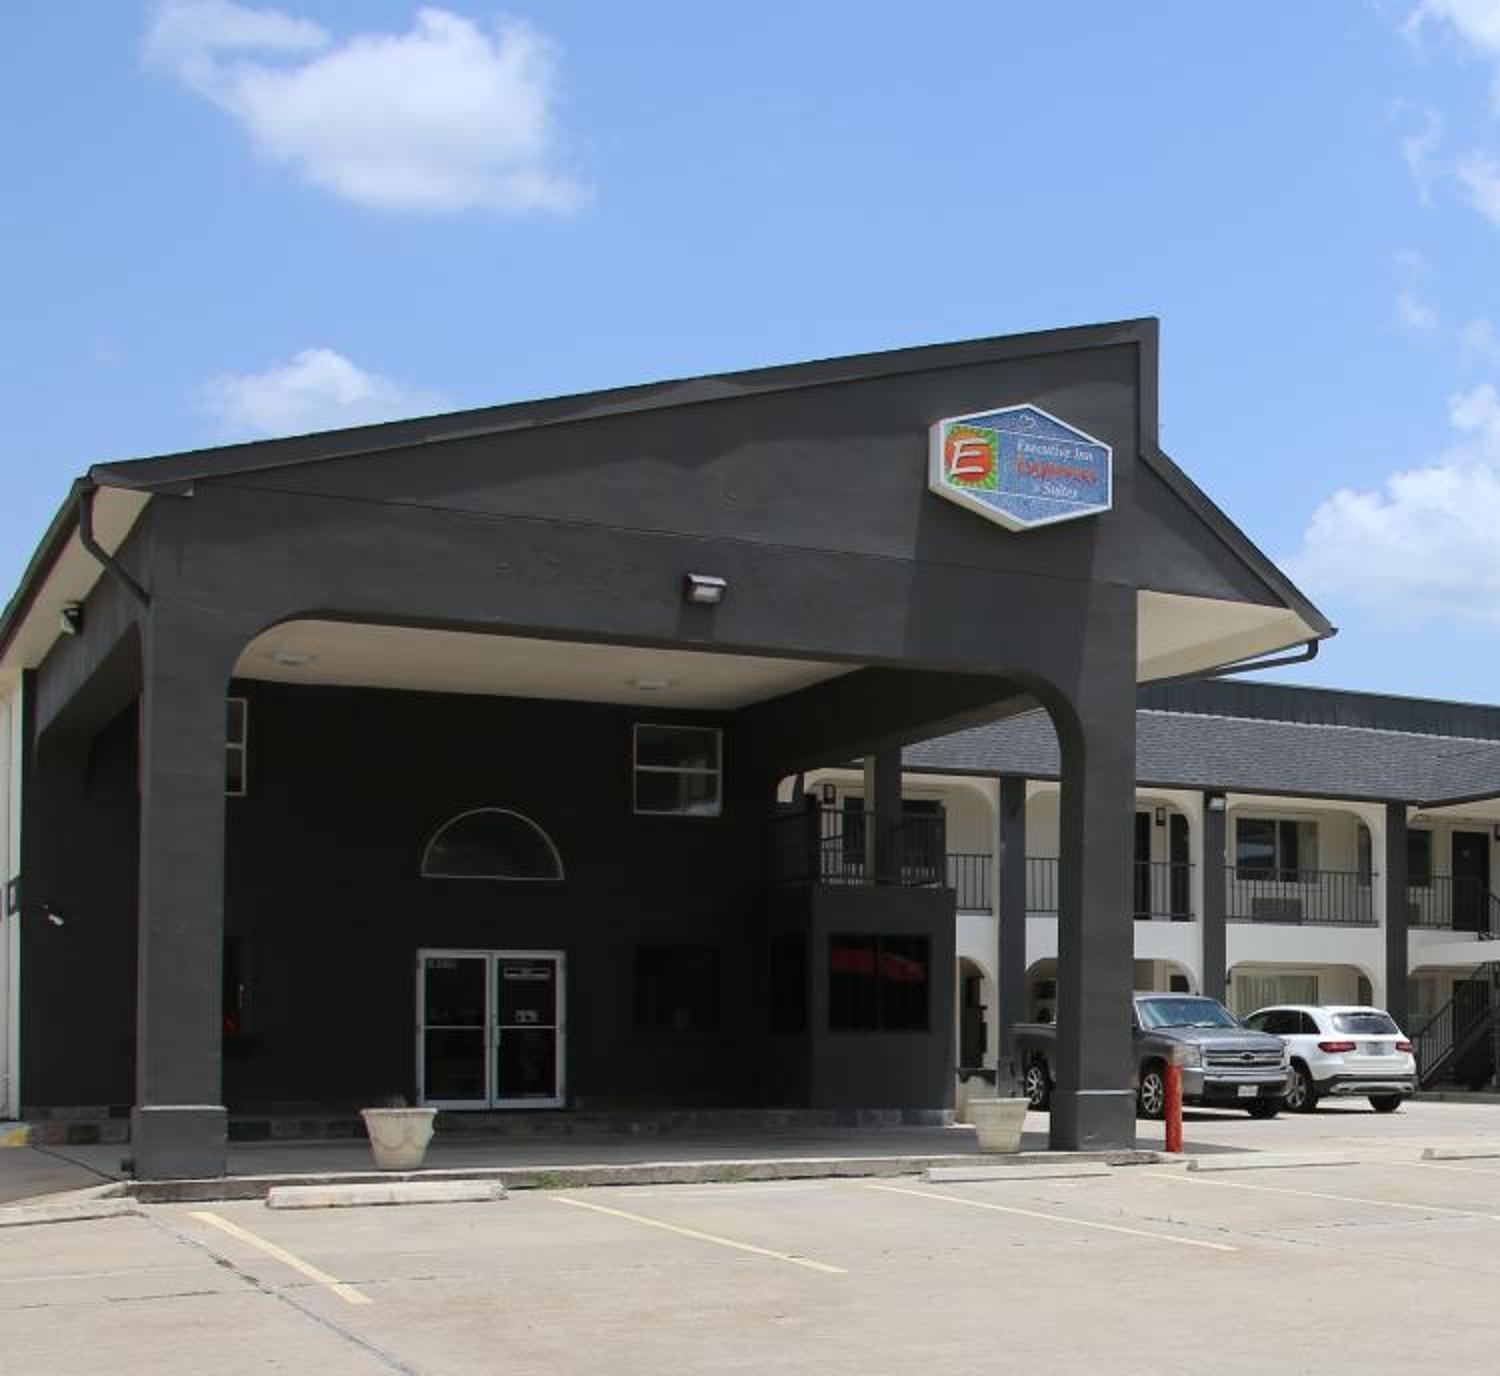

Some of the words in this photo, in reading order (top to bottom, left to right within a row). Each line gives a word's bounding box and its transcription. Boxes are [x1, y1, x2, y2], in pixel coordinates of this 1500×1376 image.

[950, 437, 989, 475] E
[1016, 441, 1070, 461] Executive
[1074, 446, 1094, 461] Inn
[1041, 482, 1078, 498] Suites
